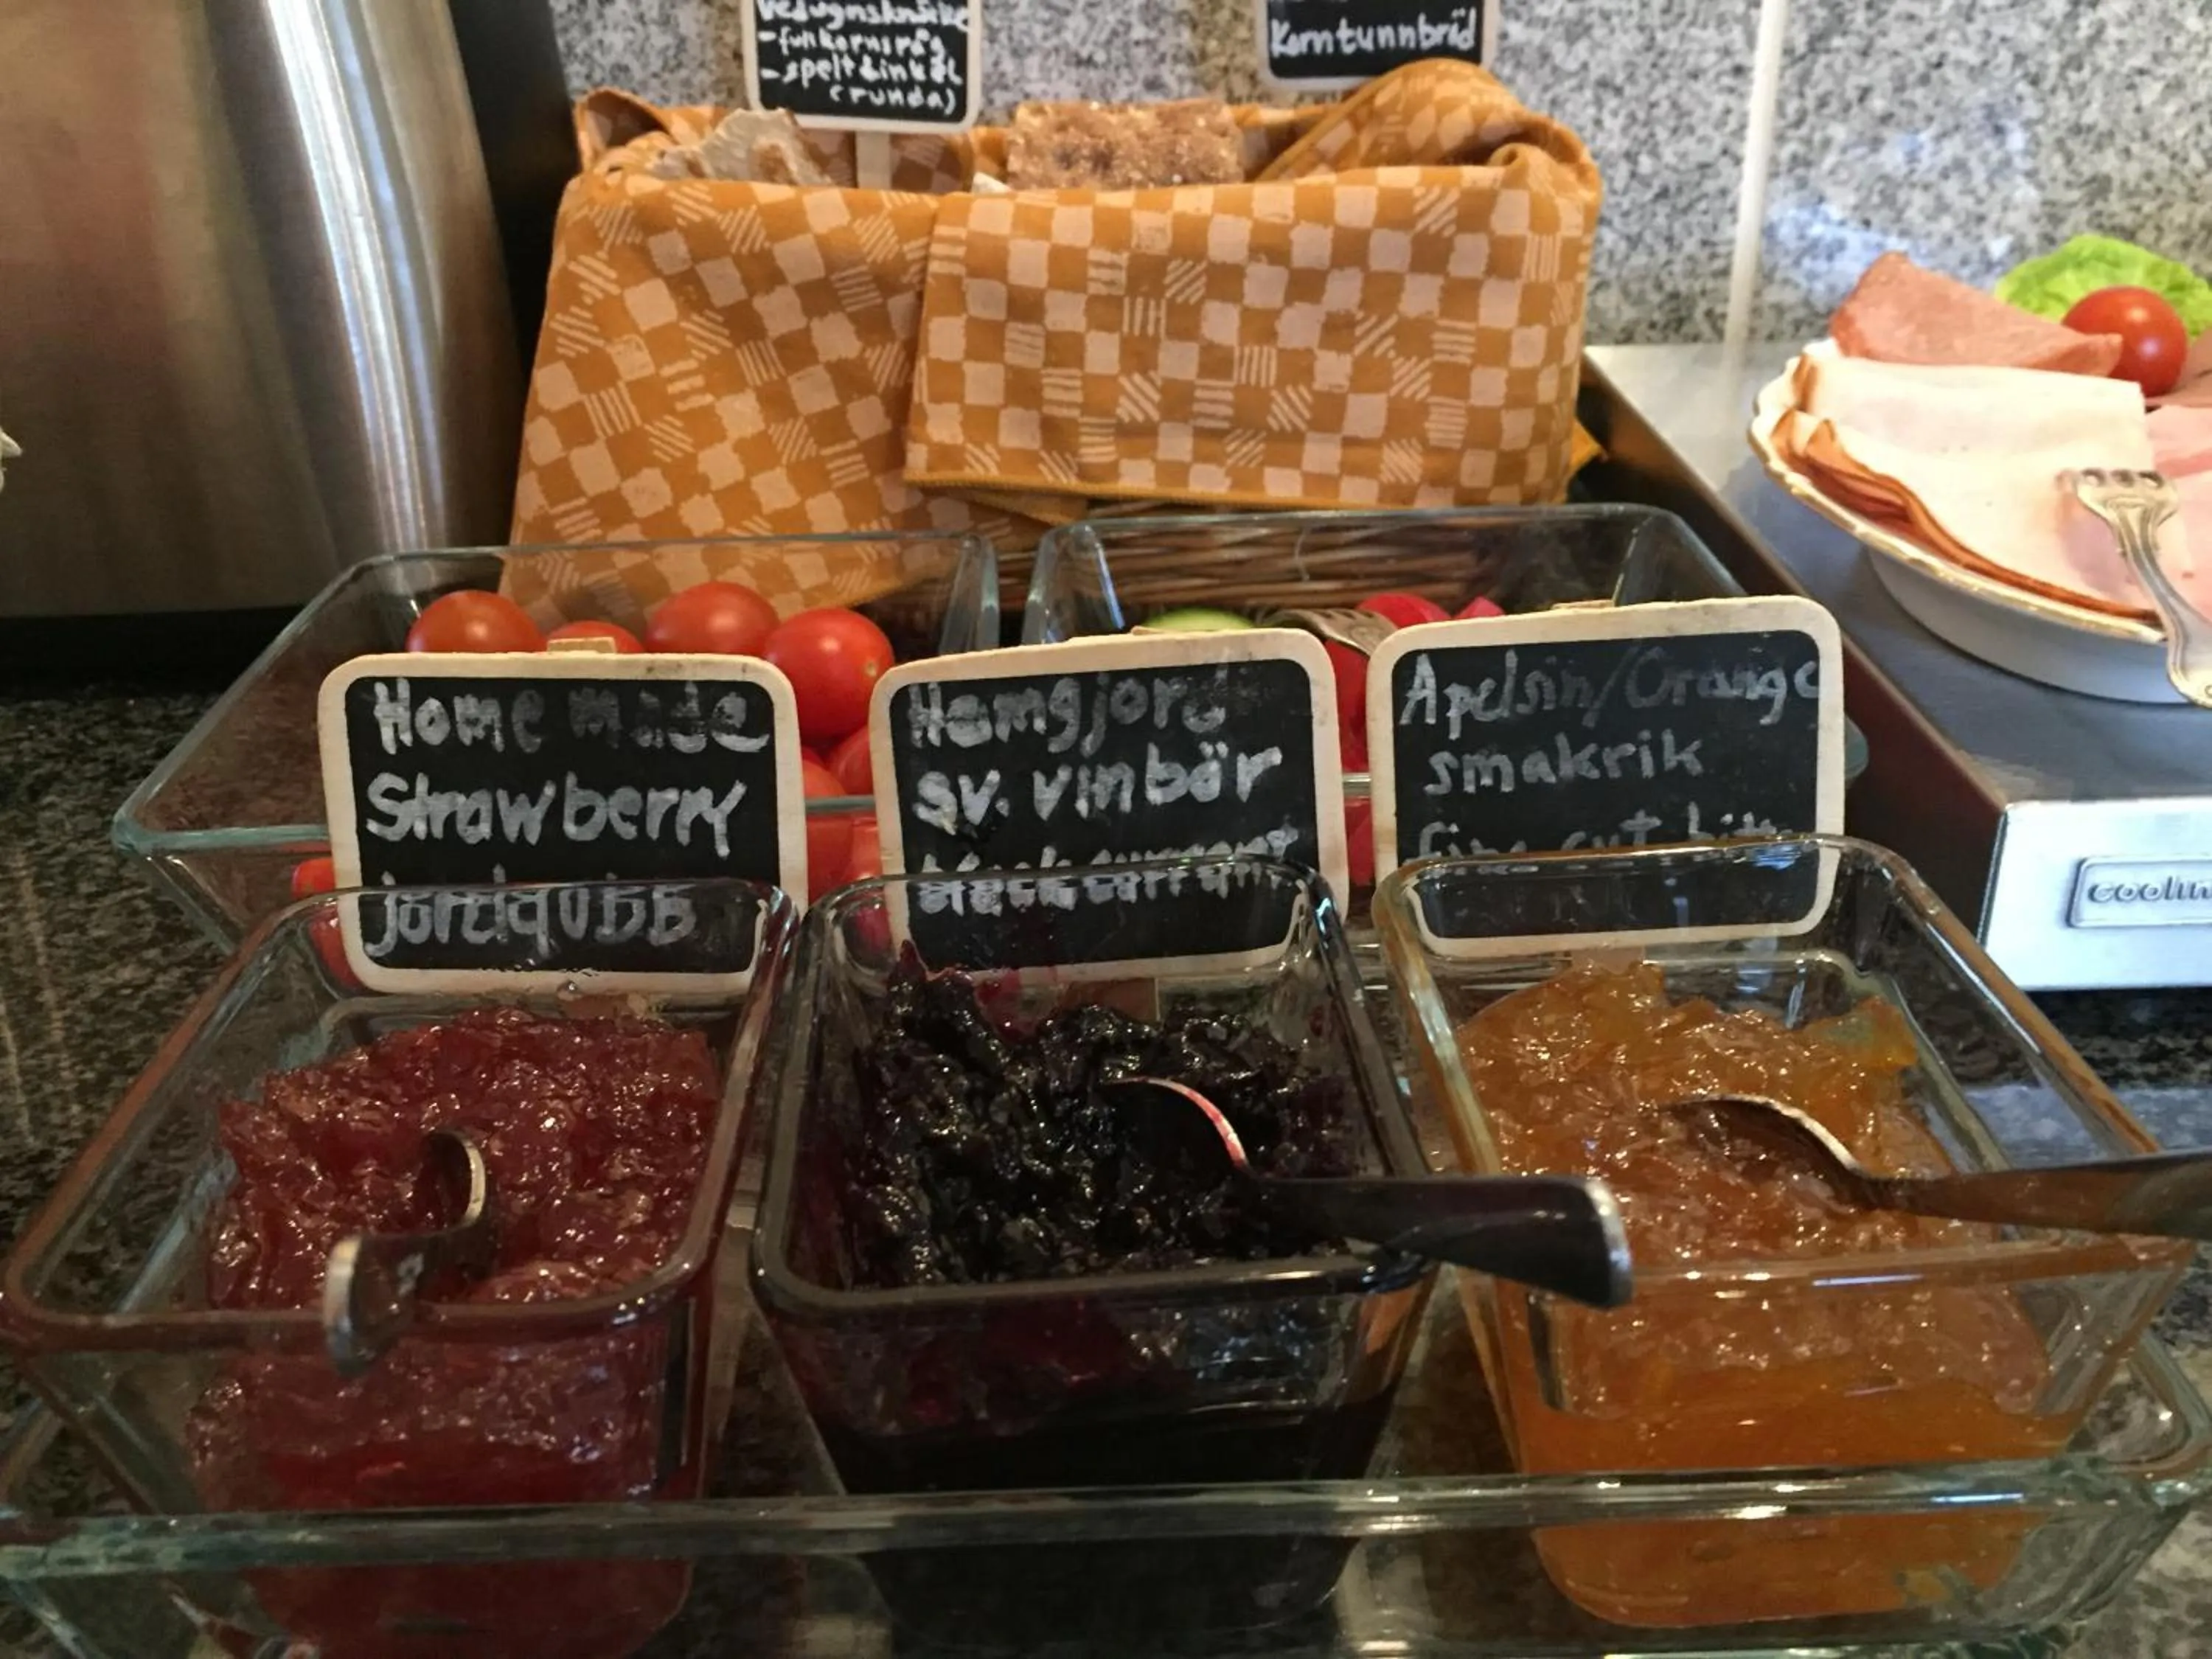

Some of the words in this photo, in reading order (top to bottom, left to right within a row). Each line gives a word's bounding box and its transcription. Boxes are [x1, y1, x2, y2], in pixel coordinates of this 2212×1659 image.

[374, 677, 544, 754] Home
[1424, 729, 1703, 796] smakrik
[366, 771, 748, 858] Strawberry
